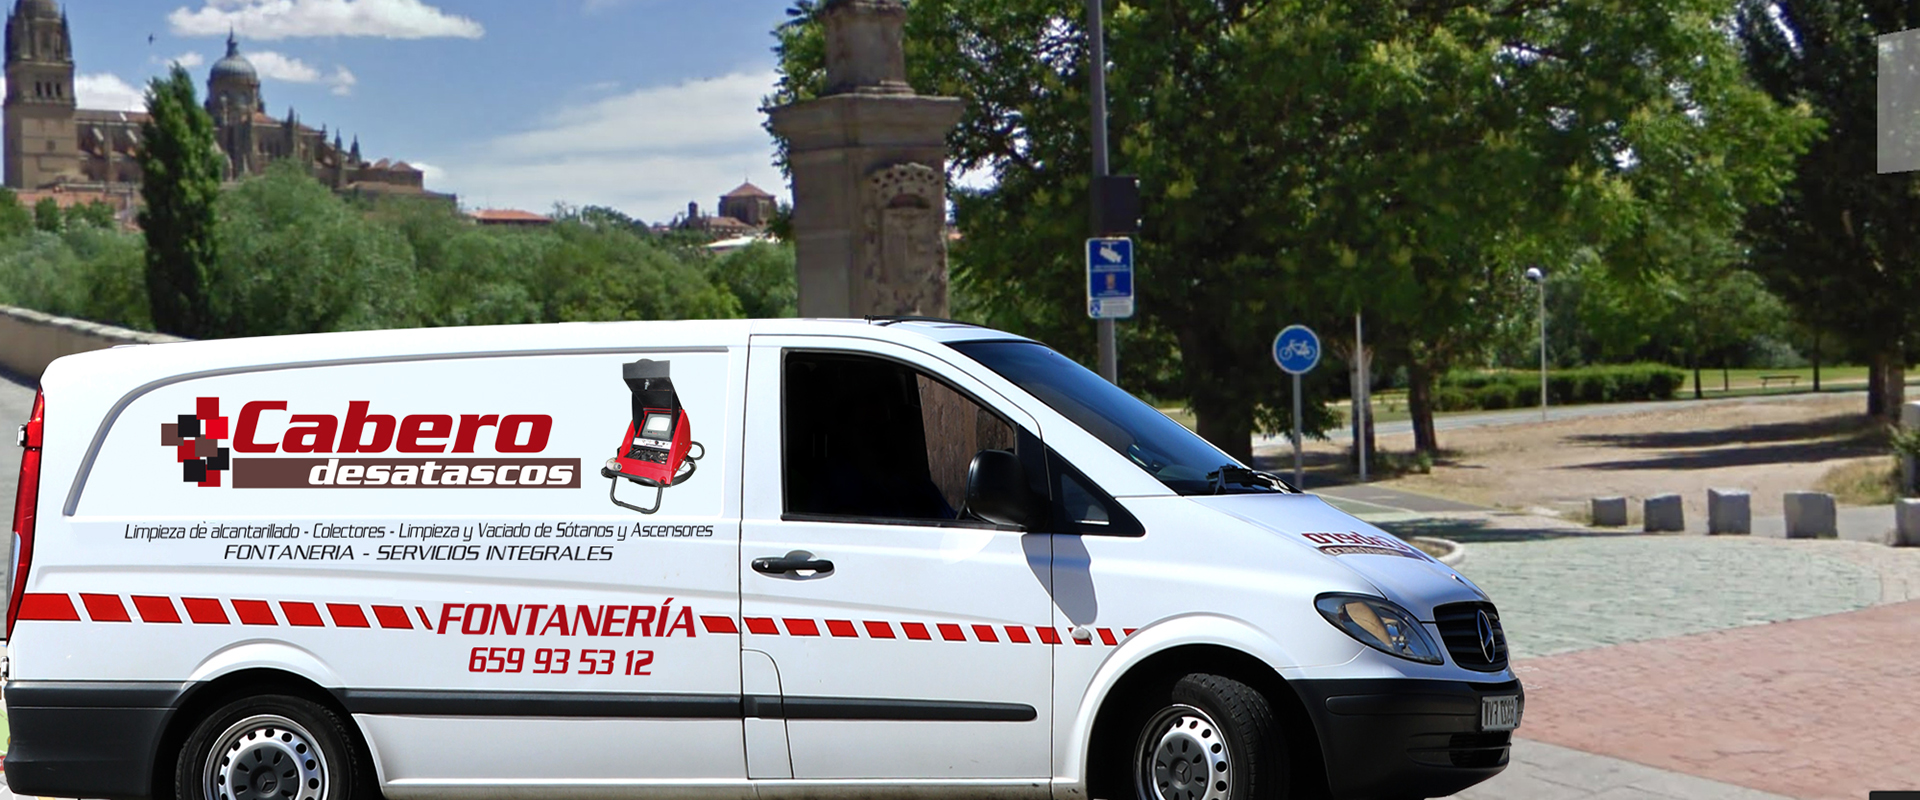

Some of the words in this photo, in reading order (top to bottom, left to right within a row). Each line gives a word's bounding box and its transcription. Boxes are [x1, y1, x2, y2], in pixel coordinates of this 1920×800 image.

[232, 400, 553, 453] Cabero
[308, 458, 575, 486] desatascos
[124, 523, 186, 542] Limpieza
[190, 523, 207, 539] de
[210, 523, 300, 539] alcantarillado
[312, 522, 386, 539] Colectores
[398, 522, 460, 542] Limpieza
[463, 526, 473, 541] y
[478, 522, 531, 538] Vaciado
[534, 522, 552, 538] de
[556, 521, 614, 538] Sótanos
[617, 525, 628, 541] y
[631, 522, 714, 538] Ascensores
[224, 544, 355, 561] FONTANERIA
[376, 544, 481, 561] SERVICIOS
[485, 545, 614, 561] INTEGRALES
[437, 597, 697, 638] FONTANERÍA
[468, 646, 526, 674] 659
[532, 648, 571, 675] 93
[577, 649, 616, 675] 53
[624, 649, 655, 676] 12
